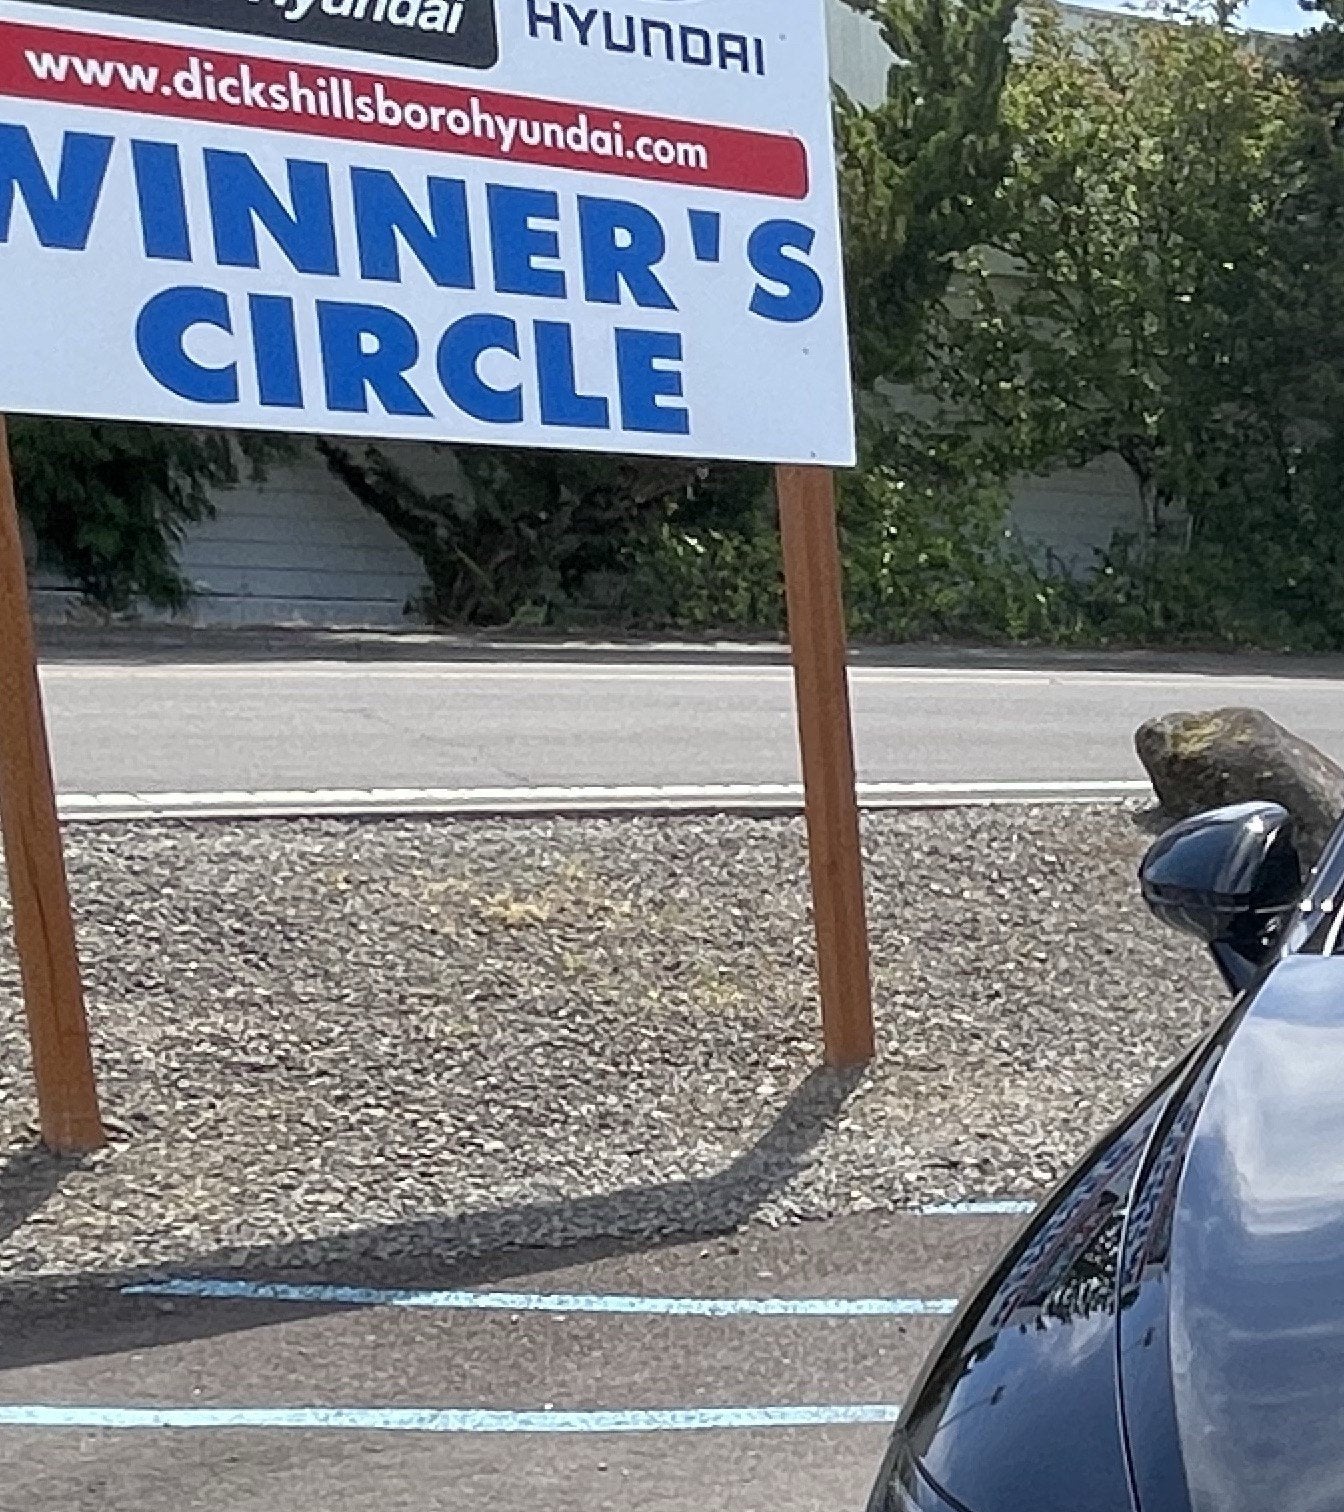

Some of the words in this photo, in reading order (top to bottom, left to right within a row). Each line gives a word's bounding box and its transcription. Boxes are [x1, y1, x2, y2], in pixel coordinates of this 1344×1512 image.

[247, 0, 464, 34] yundai
[527, 0, 765, 76] HYUNDAI
[24, 50, 708, 171] www.dickshillsborohyundai.com
[0, 122, 824, 322] WINNER'S
[135, 286, 690, 435] CIRCLE
